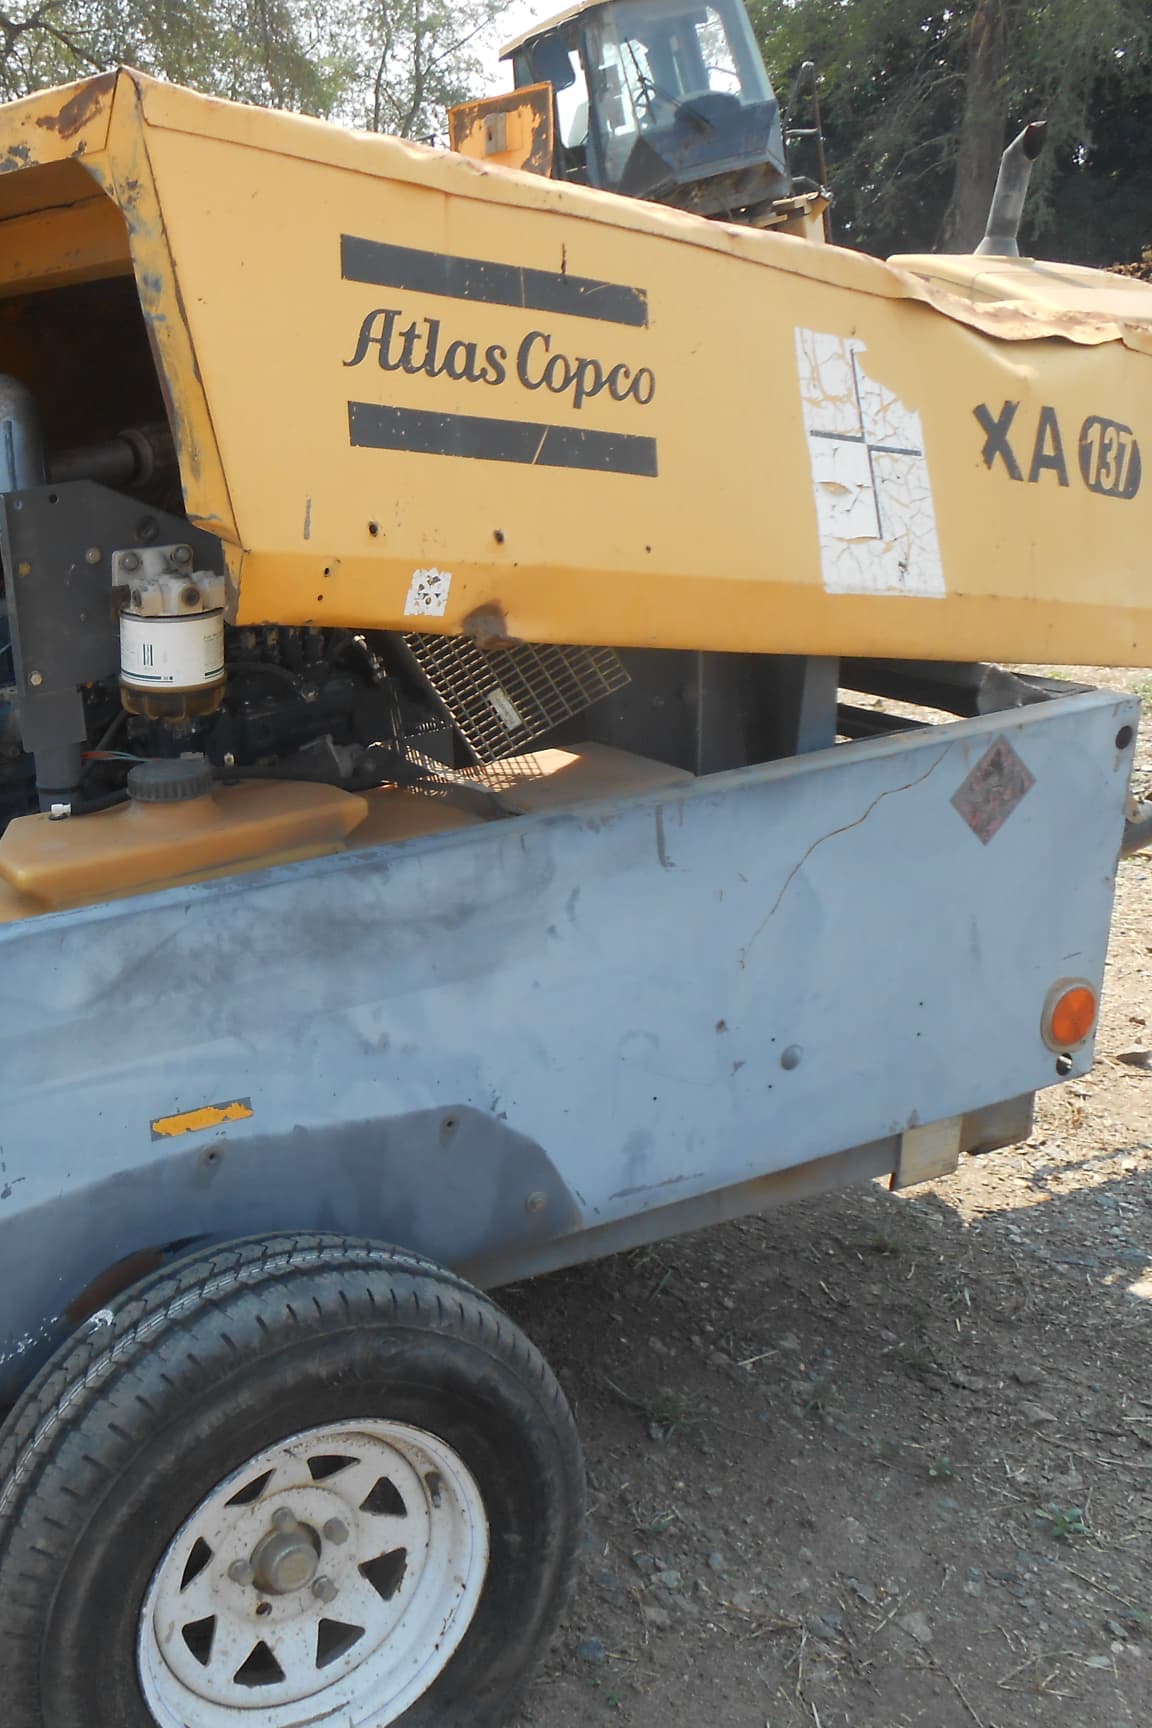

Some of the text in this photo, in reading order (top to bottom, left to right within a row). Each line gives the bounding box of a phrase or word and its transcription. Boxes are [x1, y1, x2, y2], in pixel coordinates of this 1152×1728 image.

[342, 308, 656, 410] Atlas Copco
[972, 399, 1136, 494] XA 137
